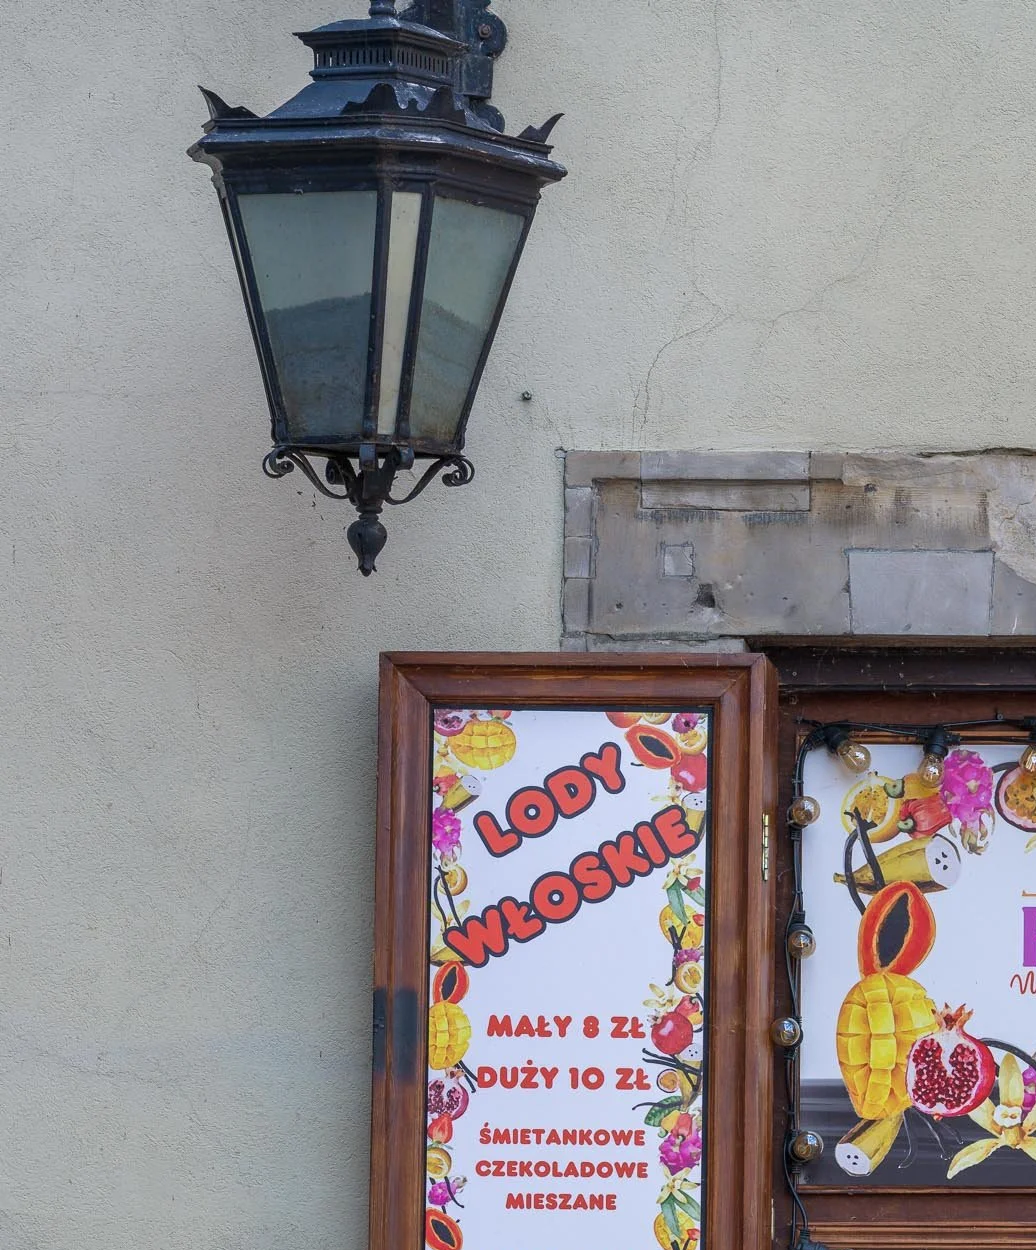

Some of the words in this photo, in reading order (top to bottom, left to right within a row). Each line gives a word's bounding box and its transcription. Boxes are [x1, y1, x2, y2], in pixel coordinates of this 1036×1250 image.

[472, 741, 626, 859] LODY
[443, 805, 702, 969] WŁOSKIE
[487, 1015, 571, 1037] MAŁY
[583, 1016, 599, 1038] 8
[611, 1017, 645, 1038] ZŁ
[477, 1060, 558, 1088] DUŻY
[570, 1068, 604, 1089] 10
[616, 1068, 650, 1090] ZŁ
[480, 1123, 648, 1145] ŚMIETANKOWE
[476, 1161, 647, 1178] CZEKOLADOWE
[506, 1194, 616, 1210] MIESZANE
